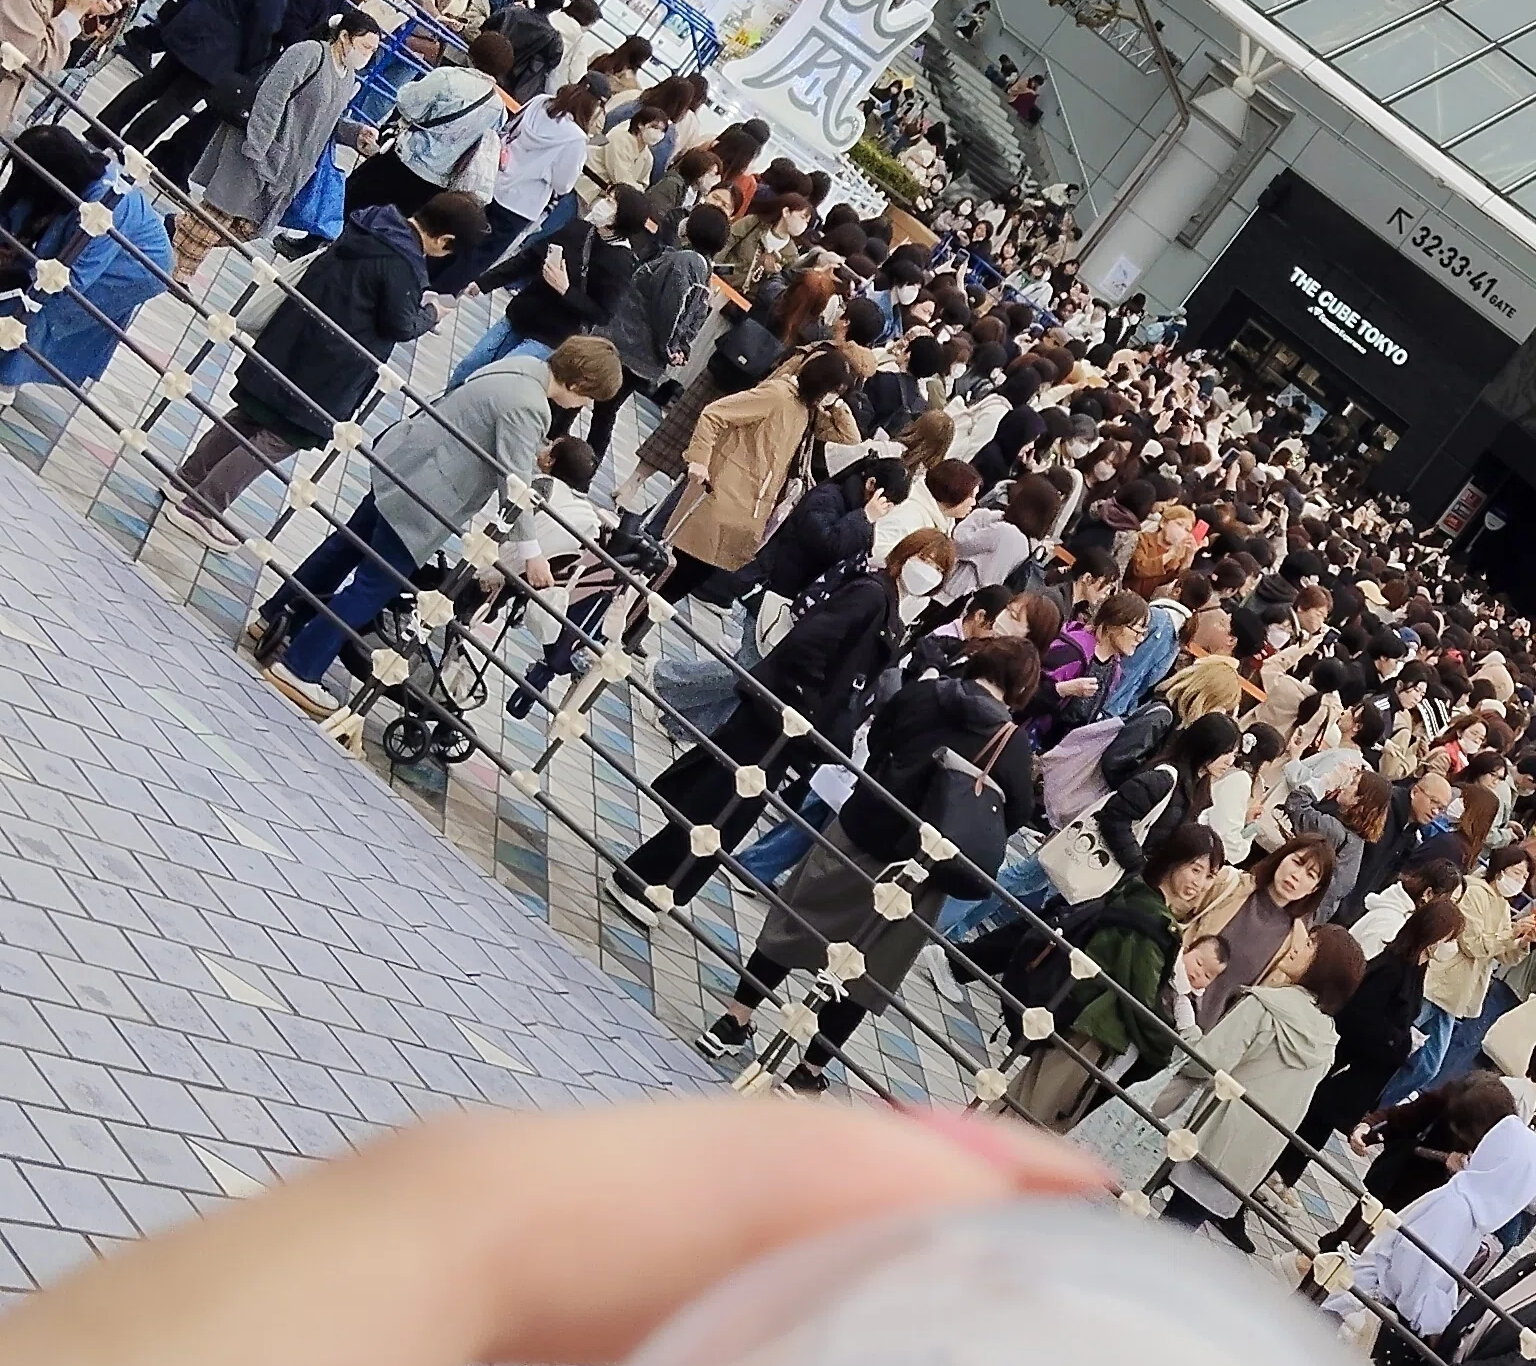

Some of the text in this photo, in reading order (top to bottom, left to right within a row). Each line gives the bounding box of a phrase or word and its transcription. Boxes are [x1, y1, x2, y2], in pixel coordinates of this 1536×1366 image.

[1290, 266, 1409, 366] THE CUBE TOKYO
[1488, 294, 1517, 319] GATE
